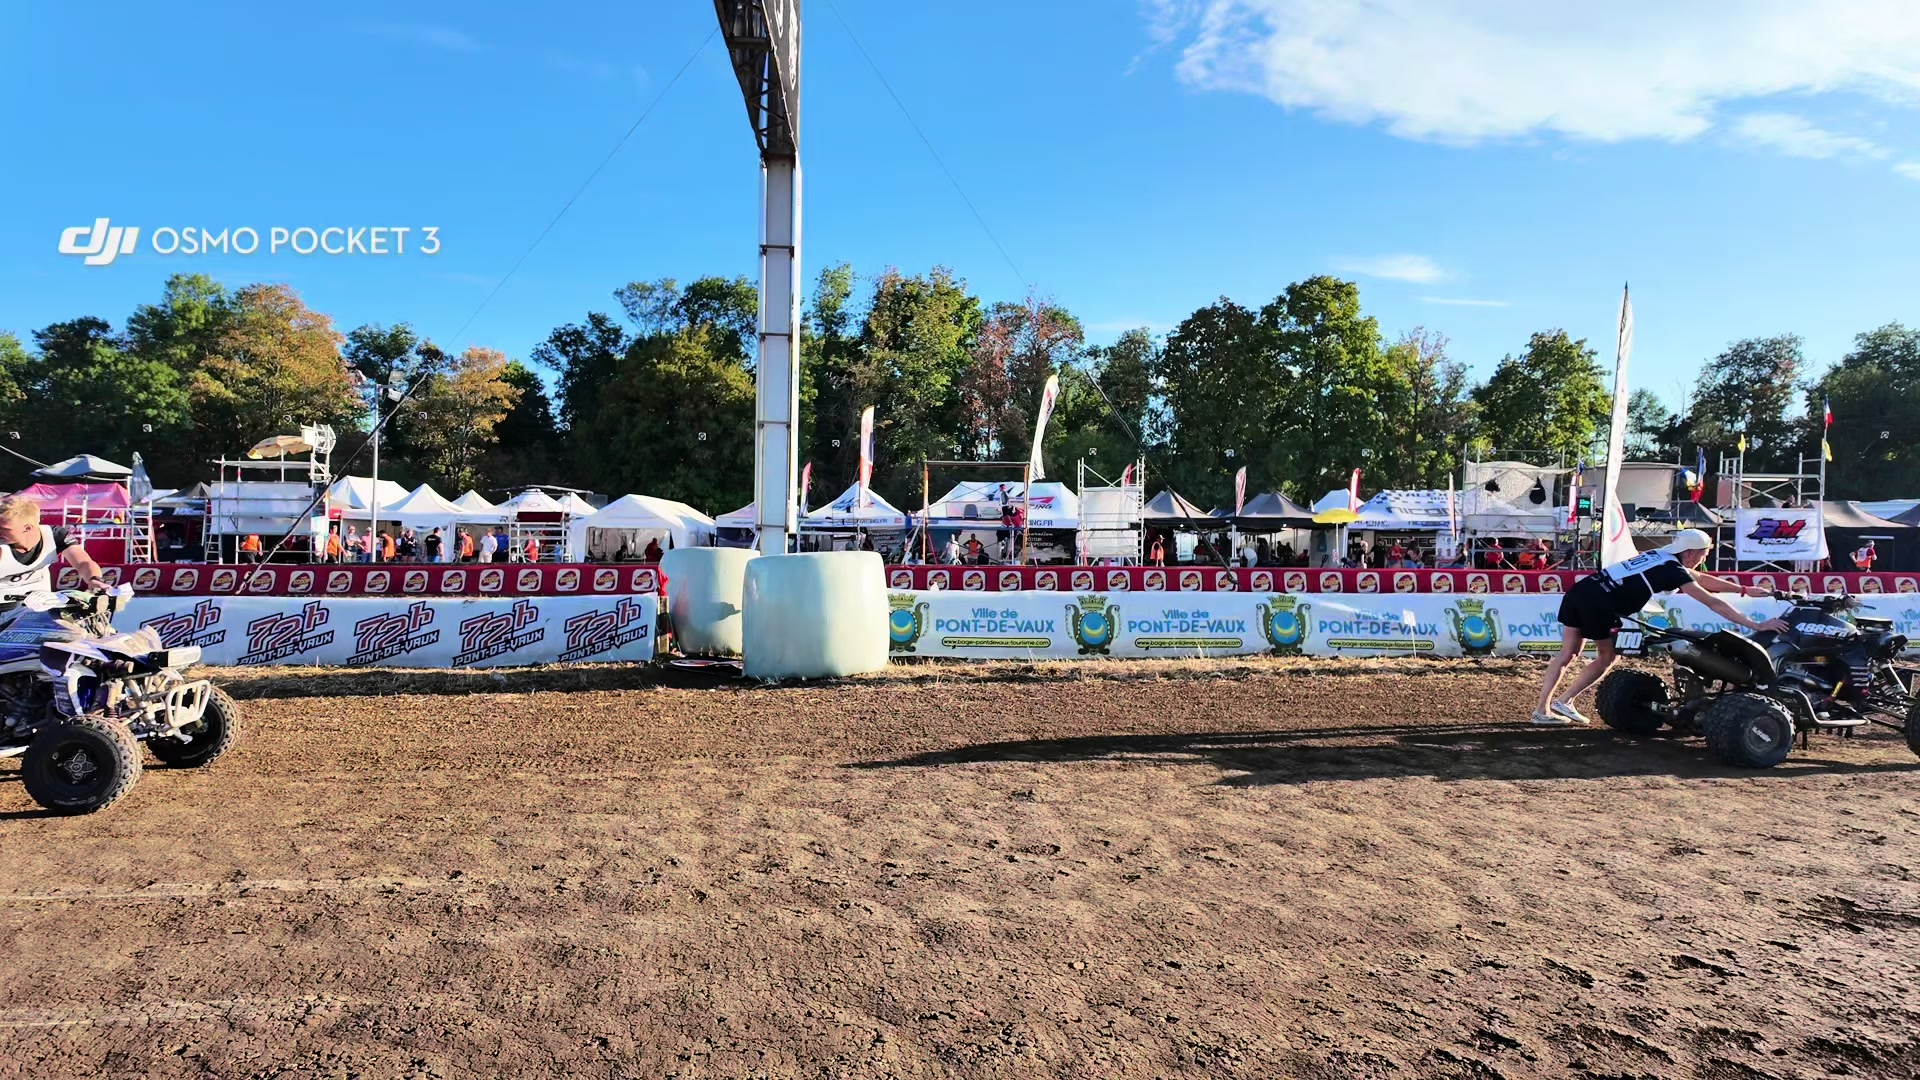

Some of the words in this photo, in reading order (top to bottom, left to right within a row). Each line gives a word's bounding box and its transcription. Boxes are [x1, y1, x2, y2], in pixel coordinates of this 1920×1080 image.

[247, 599, 329, 654] 72h
[354, 600, 434, 654] 72h
[459, 599, 539, 654] 72h
[564, 597, 641, 651] 72h
[935, 619, 1055, 633] PONT-DE-VAUX
[971, 608, 1002, 620] Ville
[1004, 608, 1018, 619] de
[1128, 619, 1246, 634] PONT-DE-VAUX
[1161, 609, 1193, 620] Ville
[1195, 609, 1210, 620] de
[1319, 620, 1439, 636] PONT-DE-VAUX
[349, 629, 439, 665] PONT-DE-VAUX
[454, 628, 544, 667] PONT-DE-VAUX
[560, 625, 648, 663] PONT-DE-VAUX
[1615, 631, 1643, 649] 100
